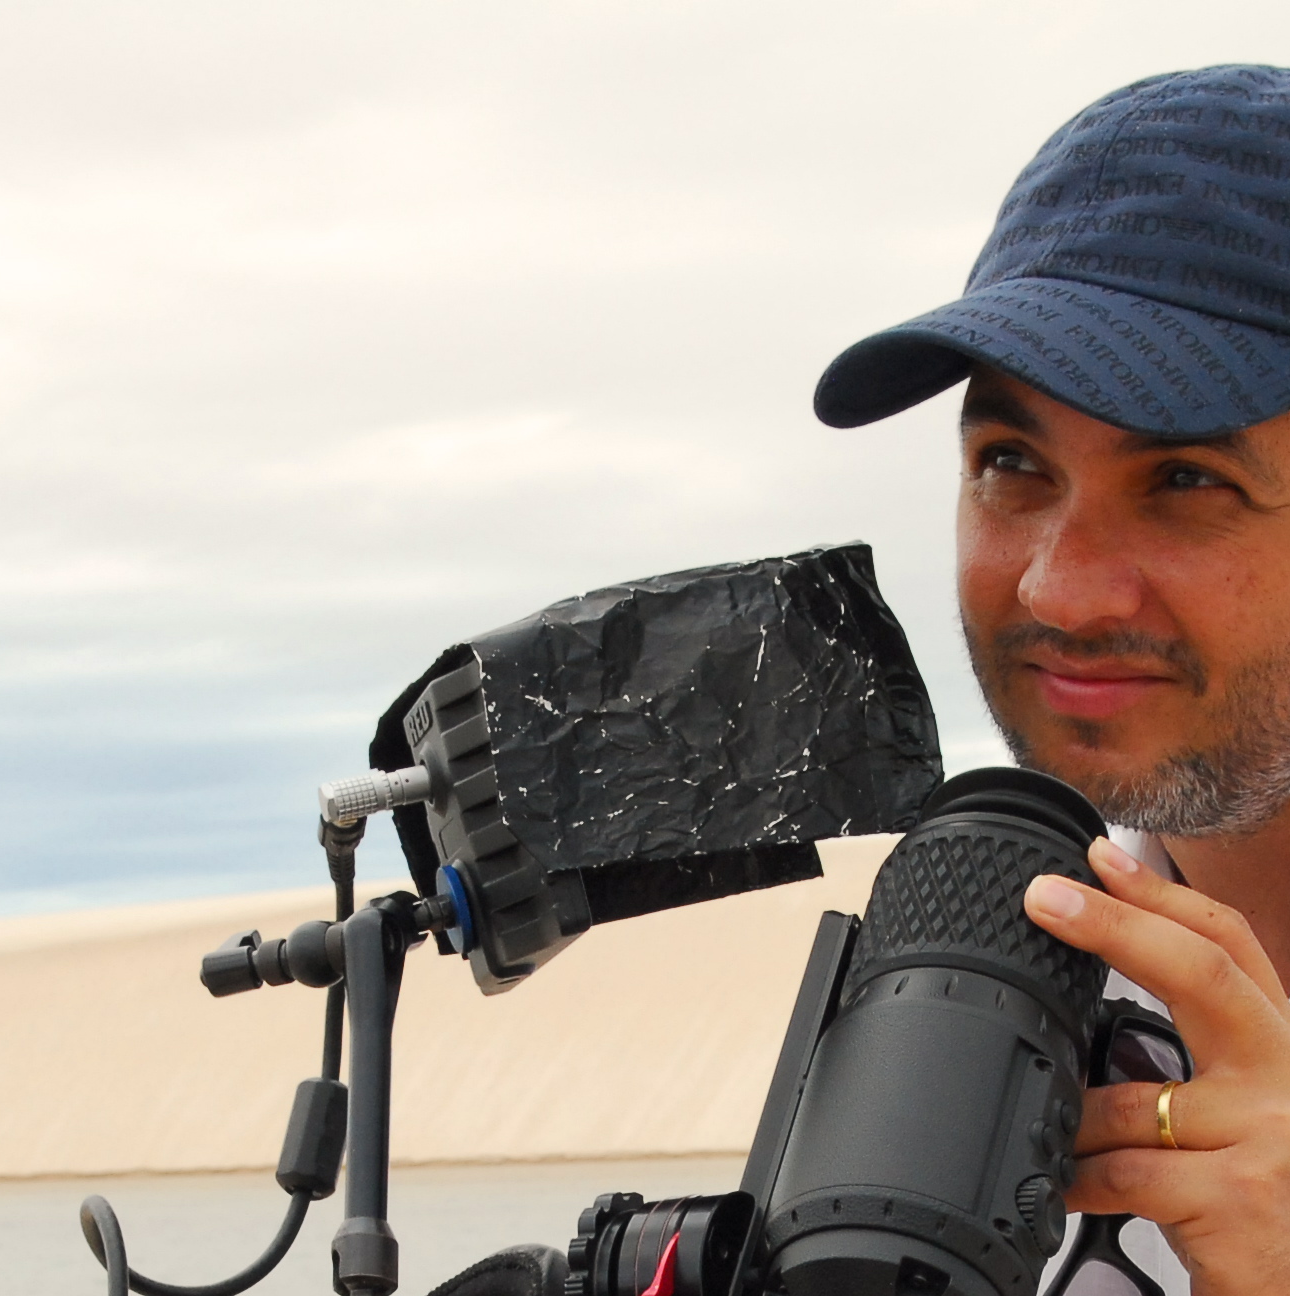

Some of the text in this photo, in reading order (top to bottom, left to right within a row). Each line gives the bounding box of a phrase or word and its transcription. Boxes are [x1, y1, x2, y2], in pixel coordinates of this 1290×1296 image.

[1064, 323, 1167, 418] EMPORIO
[1109, 317, 1210, 412] EMPORIO
[1128, 298, 1232, 386] EMPORIO
